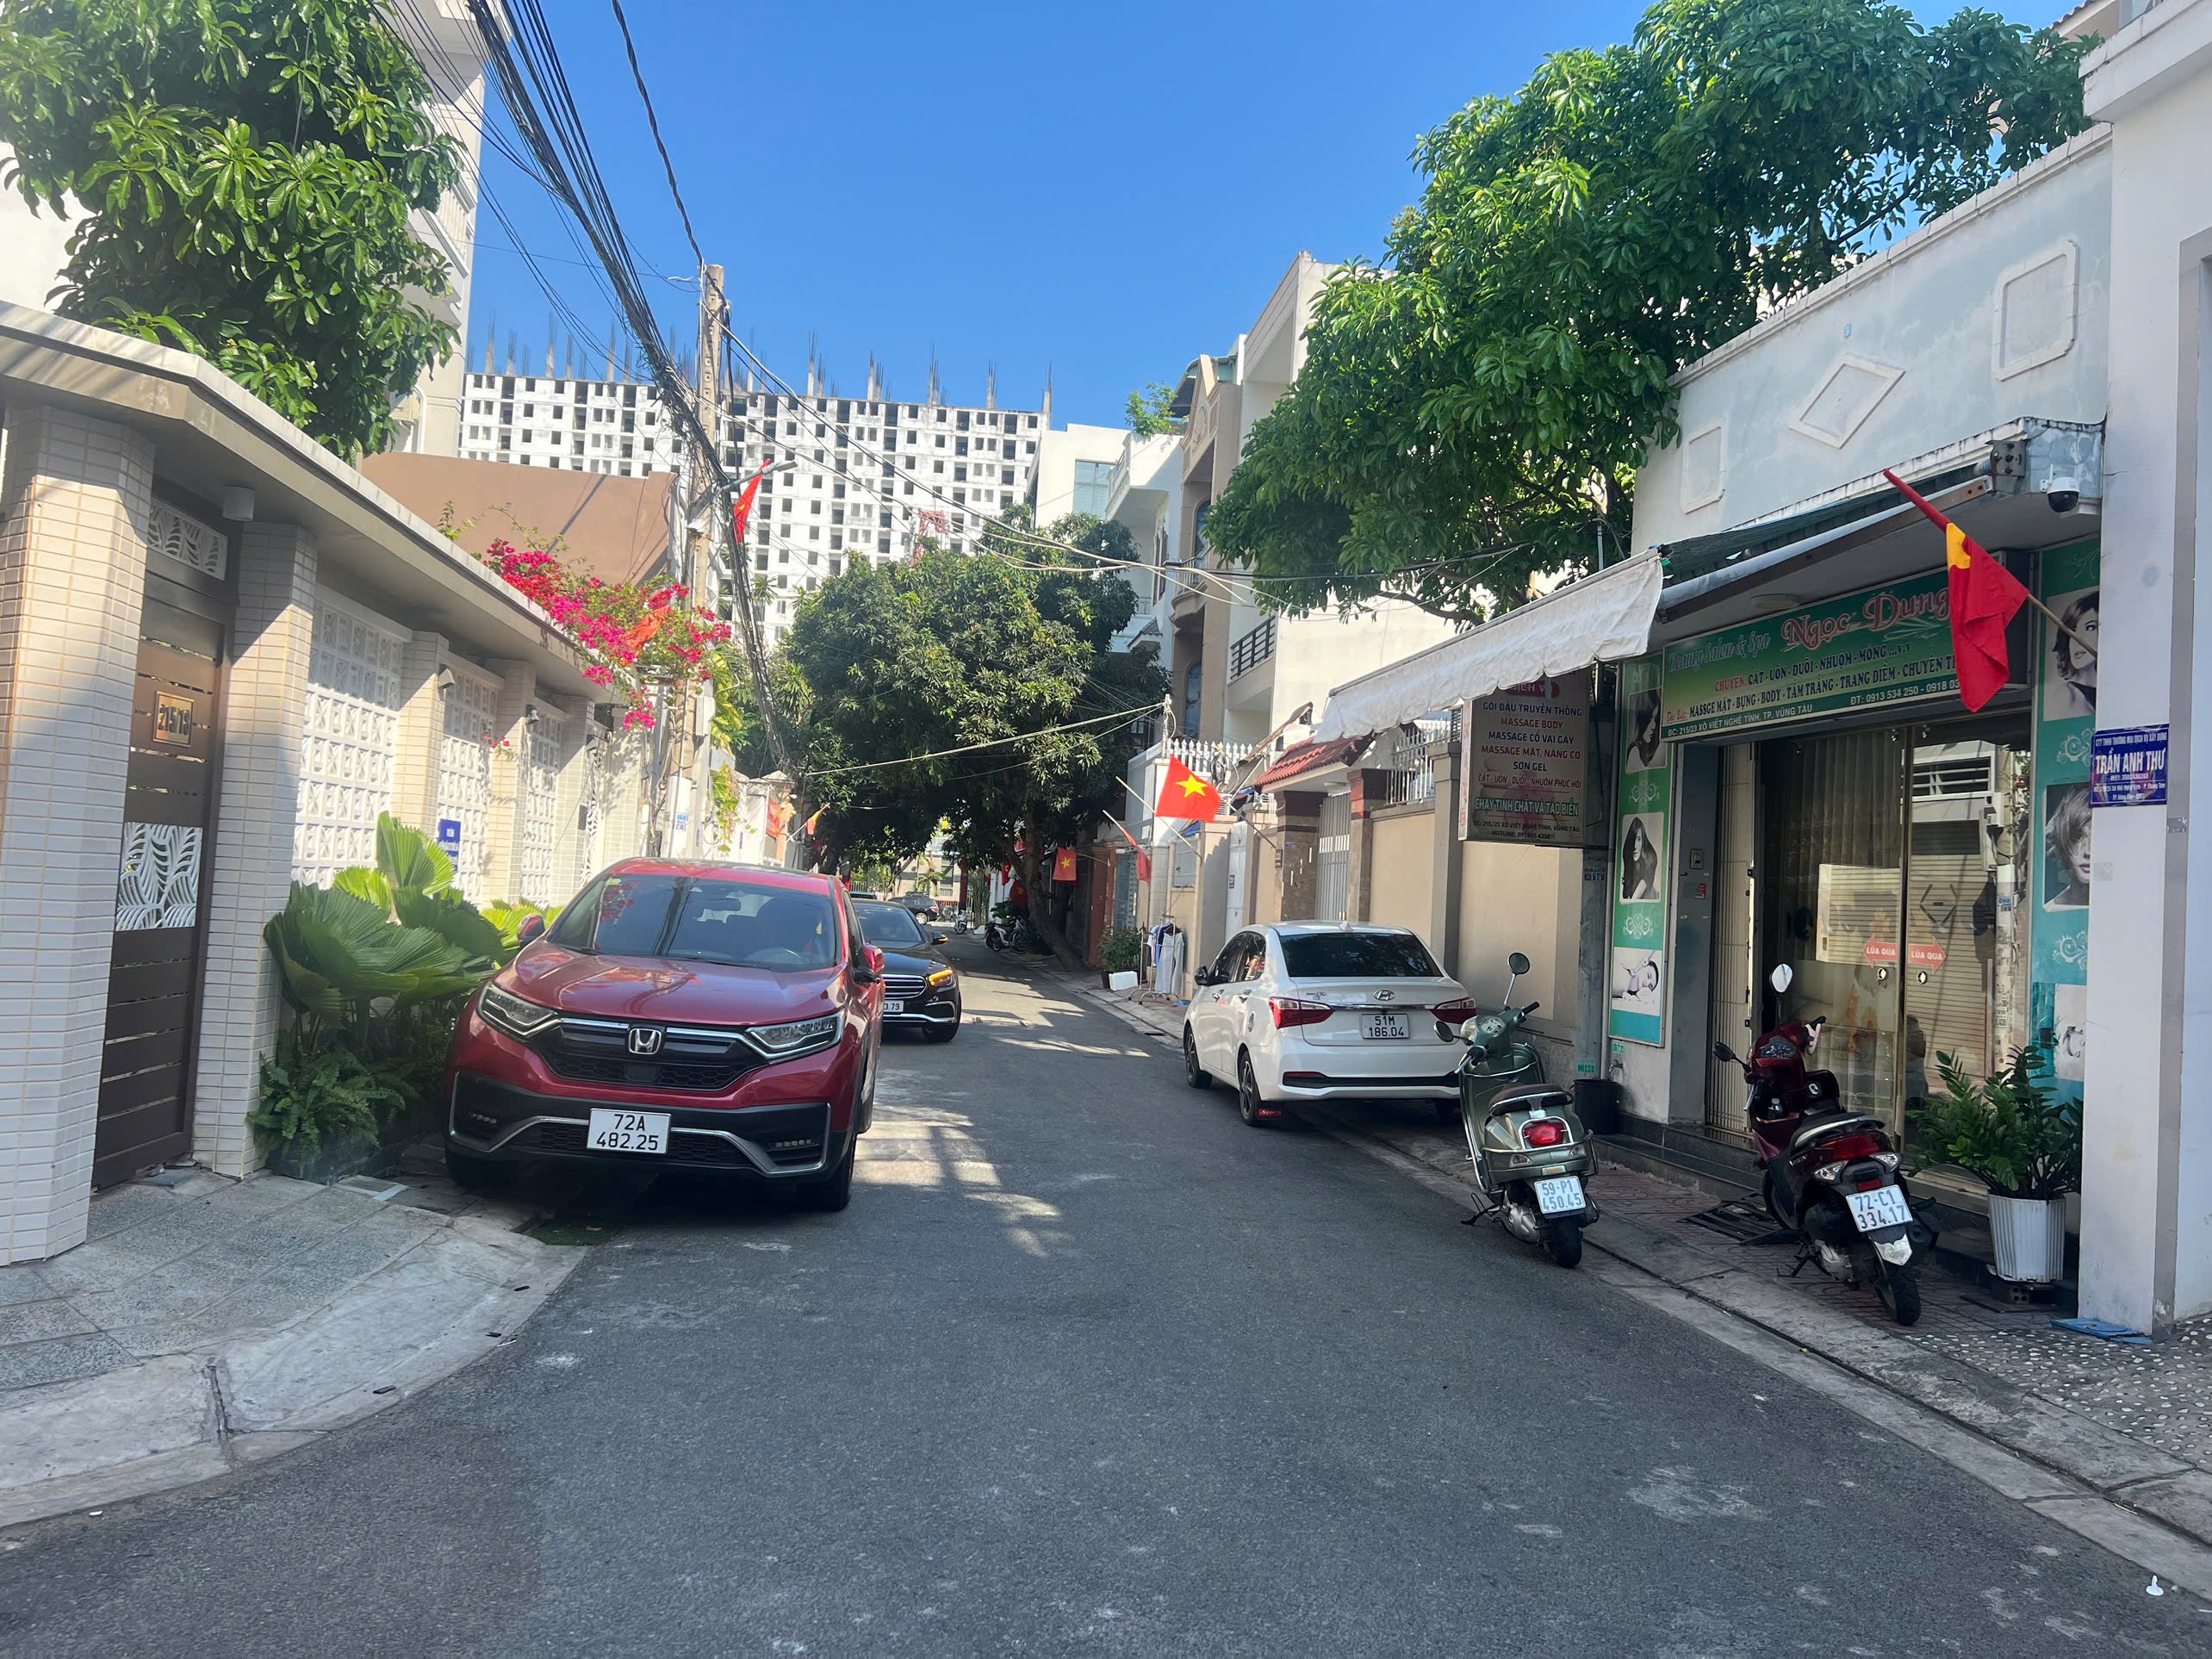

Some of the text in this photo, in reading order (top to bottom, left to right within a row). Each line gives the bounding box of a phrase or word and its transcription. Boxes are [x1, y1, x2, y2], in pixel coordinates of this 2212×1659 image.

[1780, 613, 1851, 651] Ngọc
[1748, 631, 1771, 658] Spa
[1689, 701, 1716, 718] MASSGE
[1762, 688, 1781, 704] BODY
[1840, 671, 1870, 689] TRANG
[1867, 692, 1885, 703] 0913
[1886, 689, 1901, 700] 534
[1903, 686, 1918, 697] 250
[1926, 681, 1947, 693] 0918
[1501, 718, 1563, 730] MASSAGE BODY
[1679, 724, 1698, 735] 215/23
[1488, 731, 1527, 742] MASSAGE
[1542, 735, 1555, 743] VAI
[1481, 745, 1520, 755] MASSAGE
[1532, 762, 1548, 772] GEL
[2122, 751, 2143, 772] ANH
[2146, 748, 2166, 771] THƯ
[1881, 948, 1896, 956] QUA
[1927, 951, 1942, 960] QUA
[1375, 1016, 1395, 1026] 51M
[1369, 1026, 1405, 1037] 186.04
[614, 1114, 645, 1131] 72A
[596, 1131, 659, 1151] 482.25
[1543, 1193, 1582, 1210] 450.45
[1855, 1190, 1896, 1212] 72-C1
[1857, 1205, 1905, 1229] 334.17
